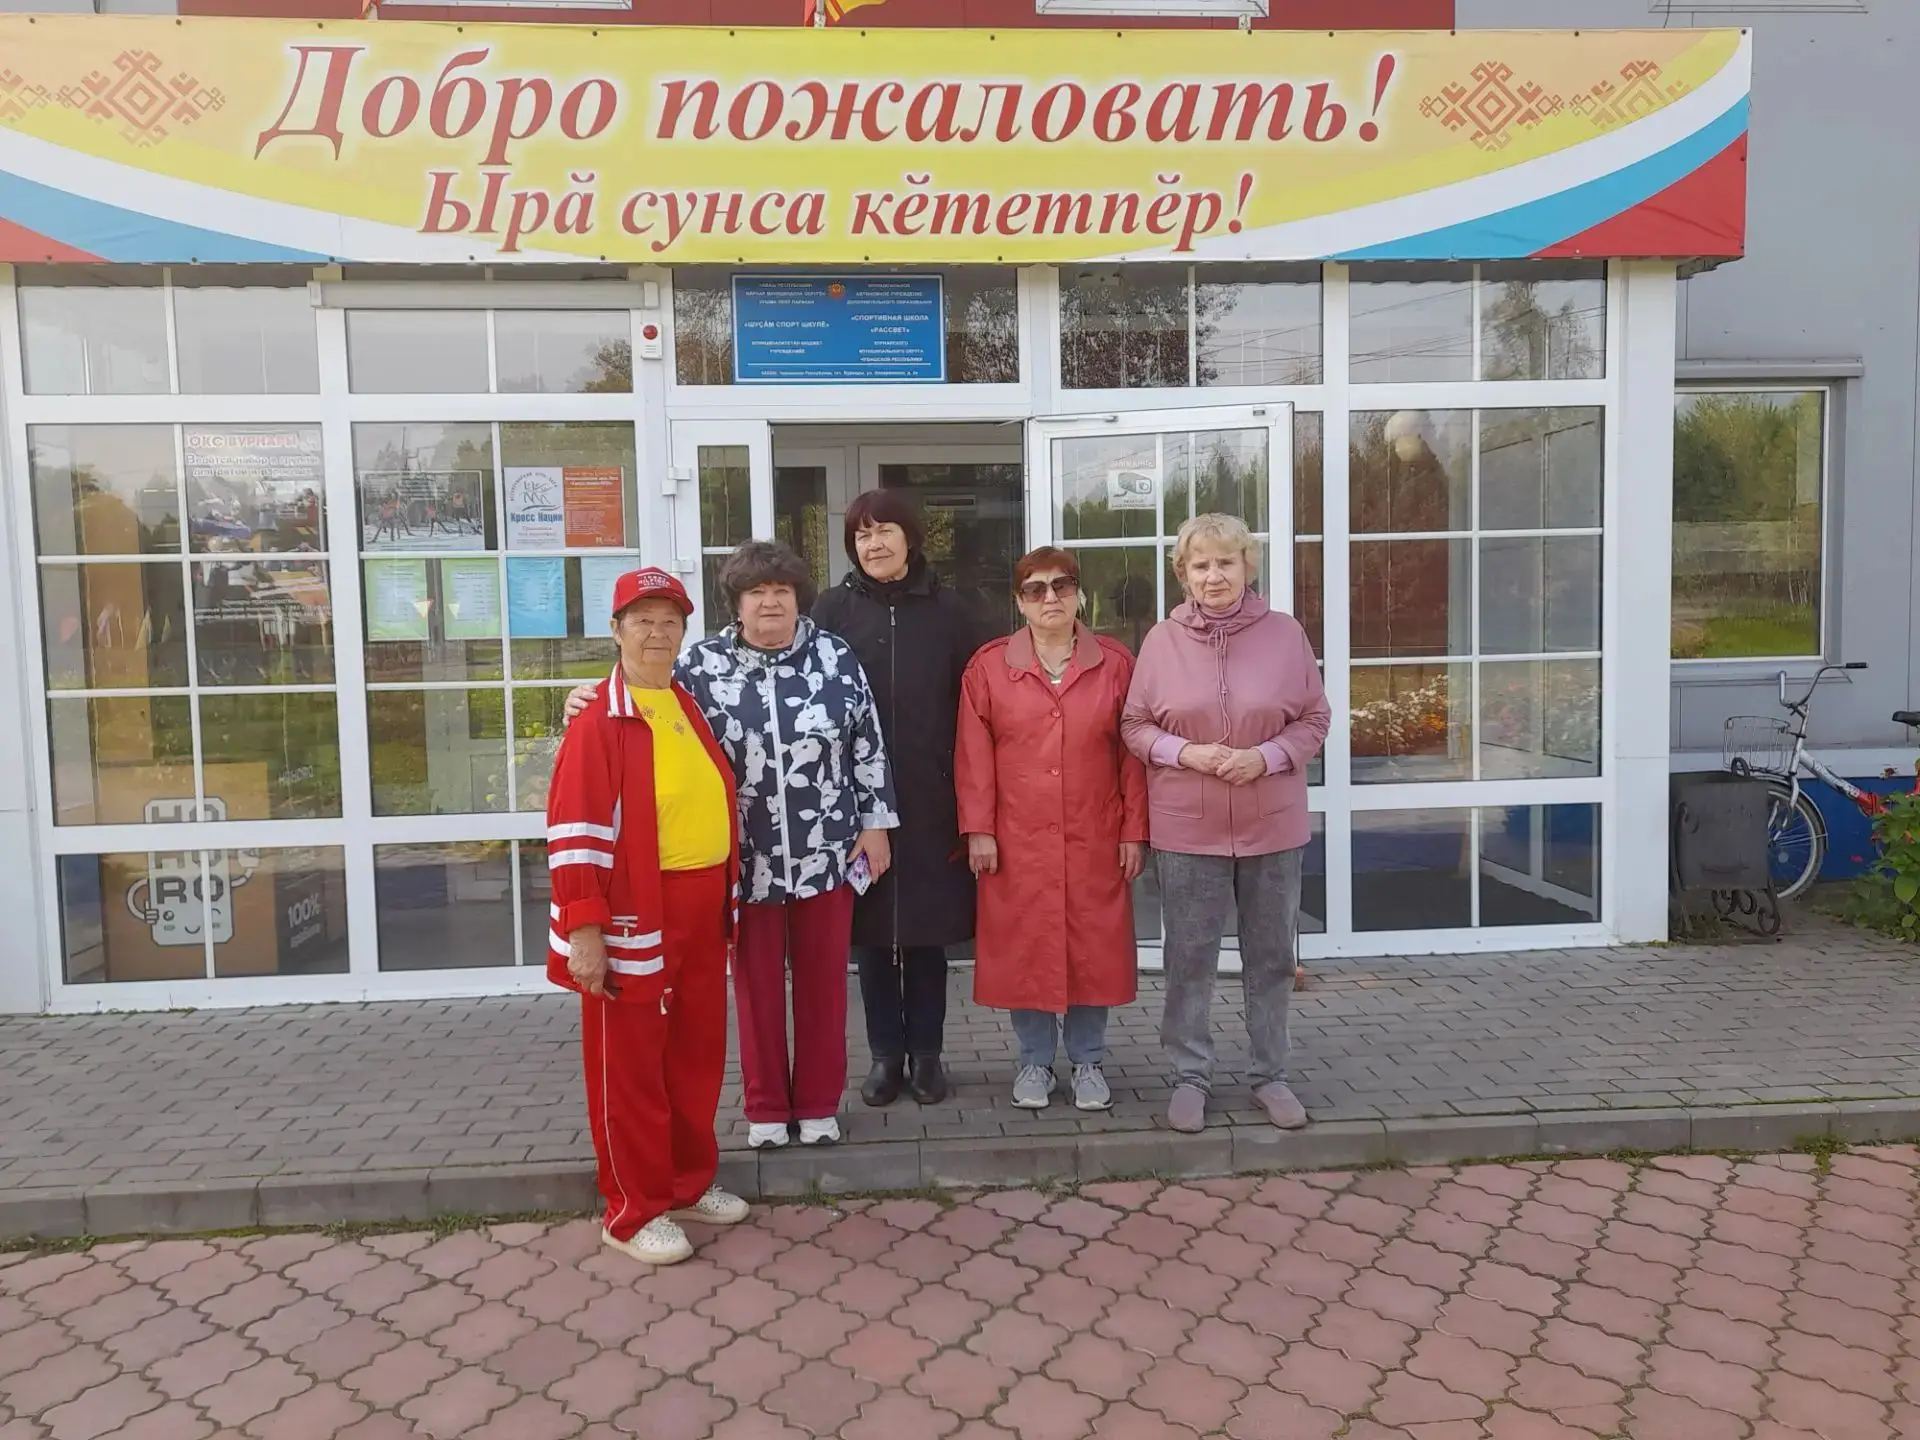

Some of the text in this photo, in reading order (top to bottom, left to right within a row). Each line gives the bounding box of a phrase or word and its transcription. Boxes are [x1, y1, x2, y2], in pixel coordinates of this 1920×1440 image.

[253, 45, 1398, 166] Добро пожаловать!
[621, 192, 825, 253] сунса
[510, 512, 563, 523] Кросс Нации
[288, 892, 321, 928] 100%
